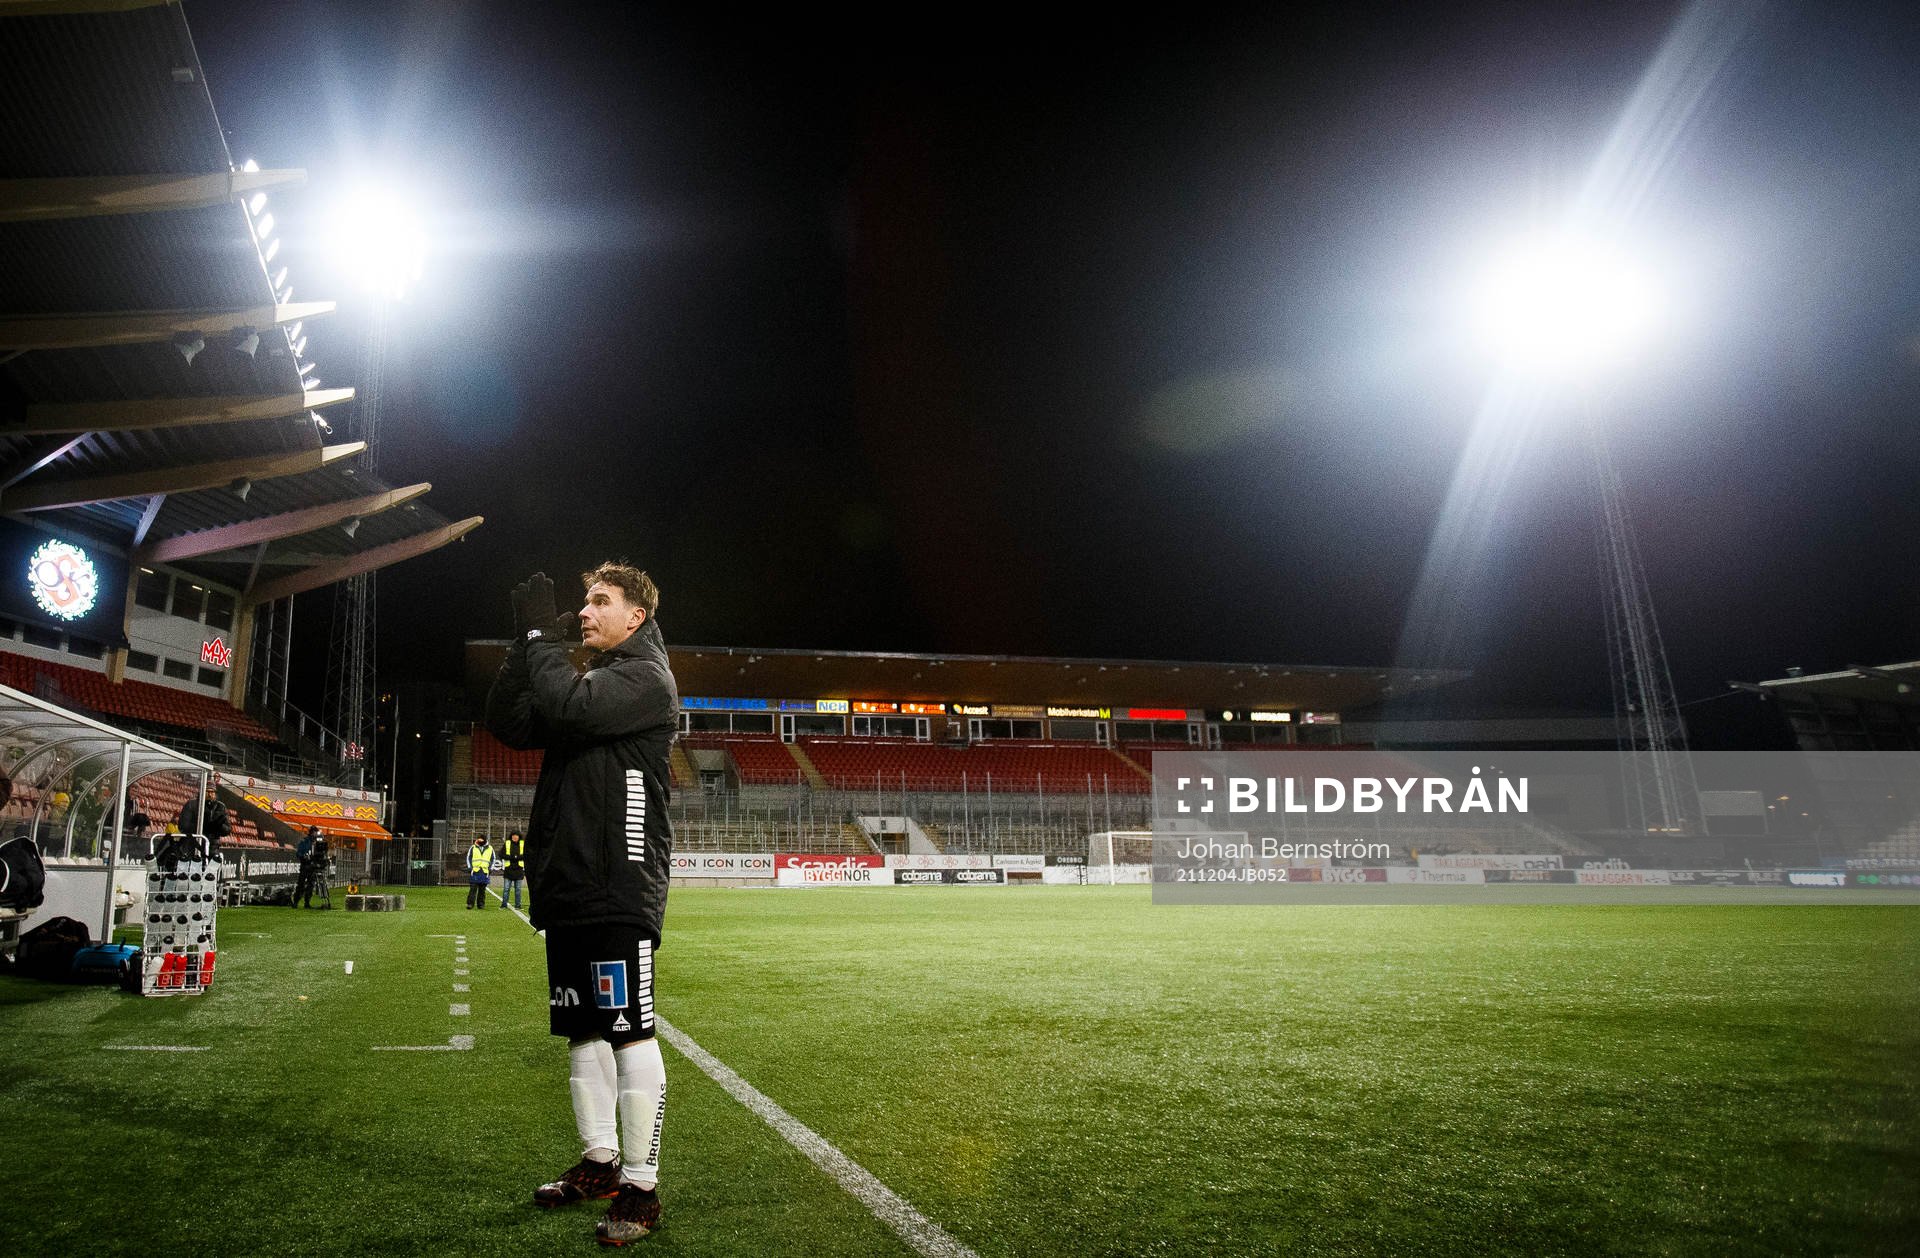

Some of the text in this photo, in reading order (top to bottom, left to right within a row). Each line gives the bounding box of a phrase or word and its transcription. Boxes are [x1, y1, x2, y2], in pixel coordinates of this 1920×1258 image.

[201, 637, 232, 668] MAX
[1047, 707, 1100, 718] Mobilverkstan
[670, 859, 771, 868] CON ICON ICON
[902, 870, 998, 881] colorama colorama
[645, 1083, 667, 1167] BRÖDERNAS
